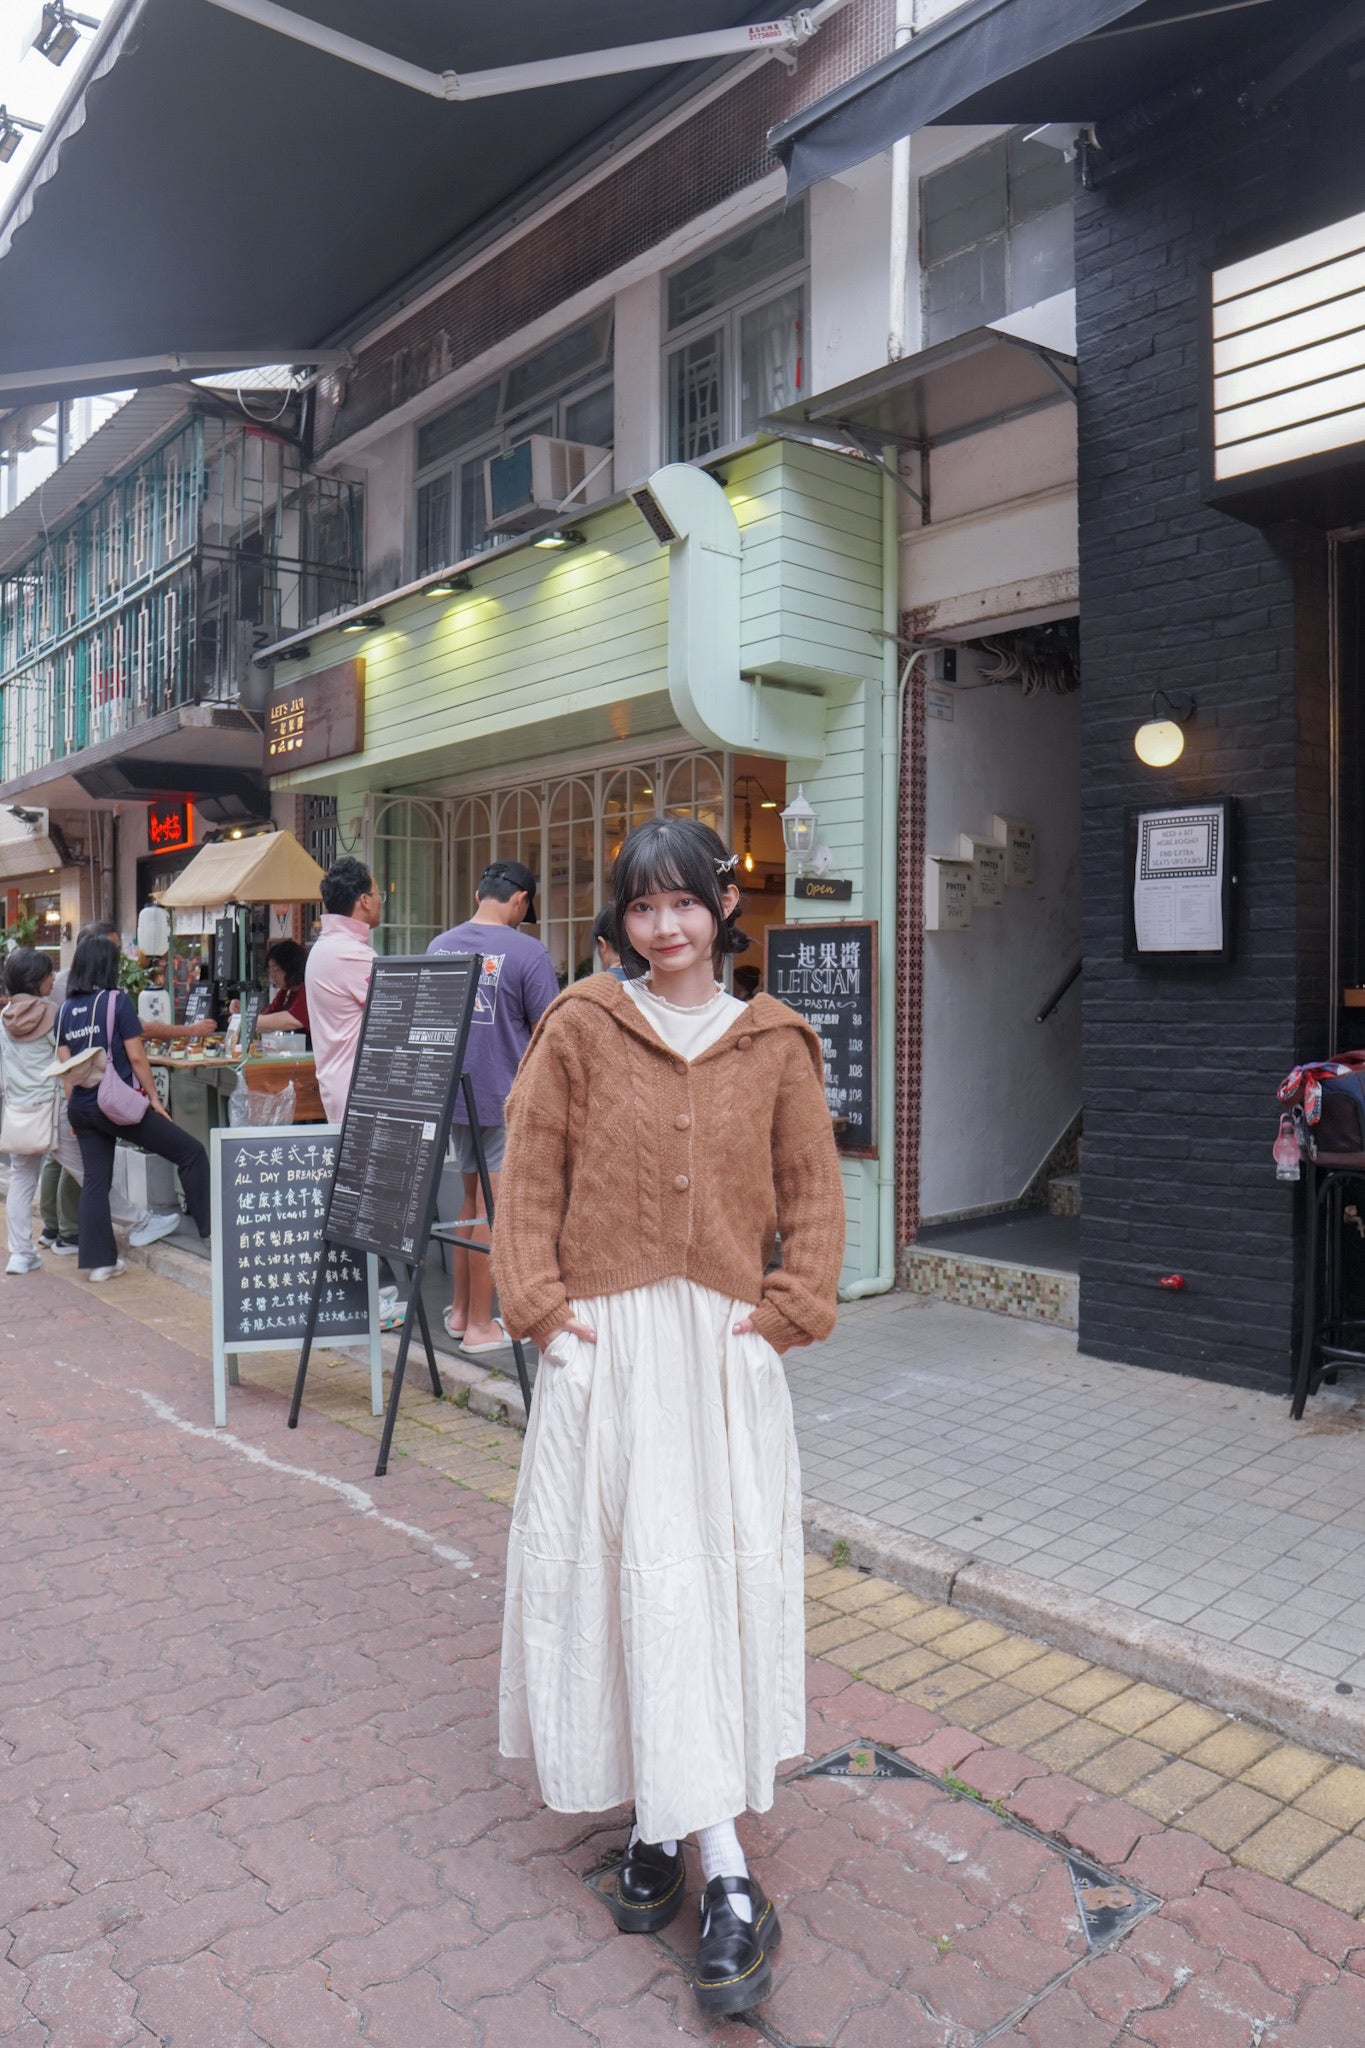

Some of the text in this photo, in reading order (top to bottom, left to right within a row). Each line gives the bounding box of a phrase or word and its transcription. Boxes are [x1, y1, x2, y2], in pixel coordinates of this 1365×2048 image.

[806, 882, 836, 896] Open
[777, 941, 860, 968] 一起果醬
[804, 998, 836, 1010] PASTA
[848, 1038, 862, 1052] 108
[848, 1064, 862, 1078] 108
[848, 1089, 862, 1102] 108
[849, 1112, 862, 1125] 128
[234, 1144, 335, 1168] 全天英式早餐
[234, 1173, 252, 1186] ALL
[260, 1172, 280, 1183] DAY
[236, 1214, 253, 1226] ALL
[254, 1213, 272, 1223] DAY
